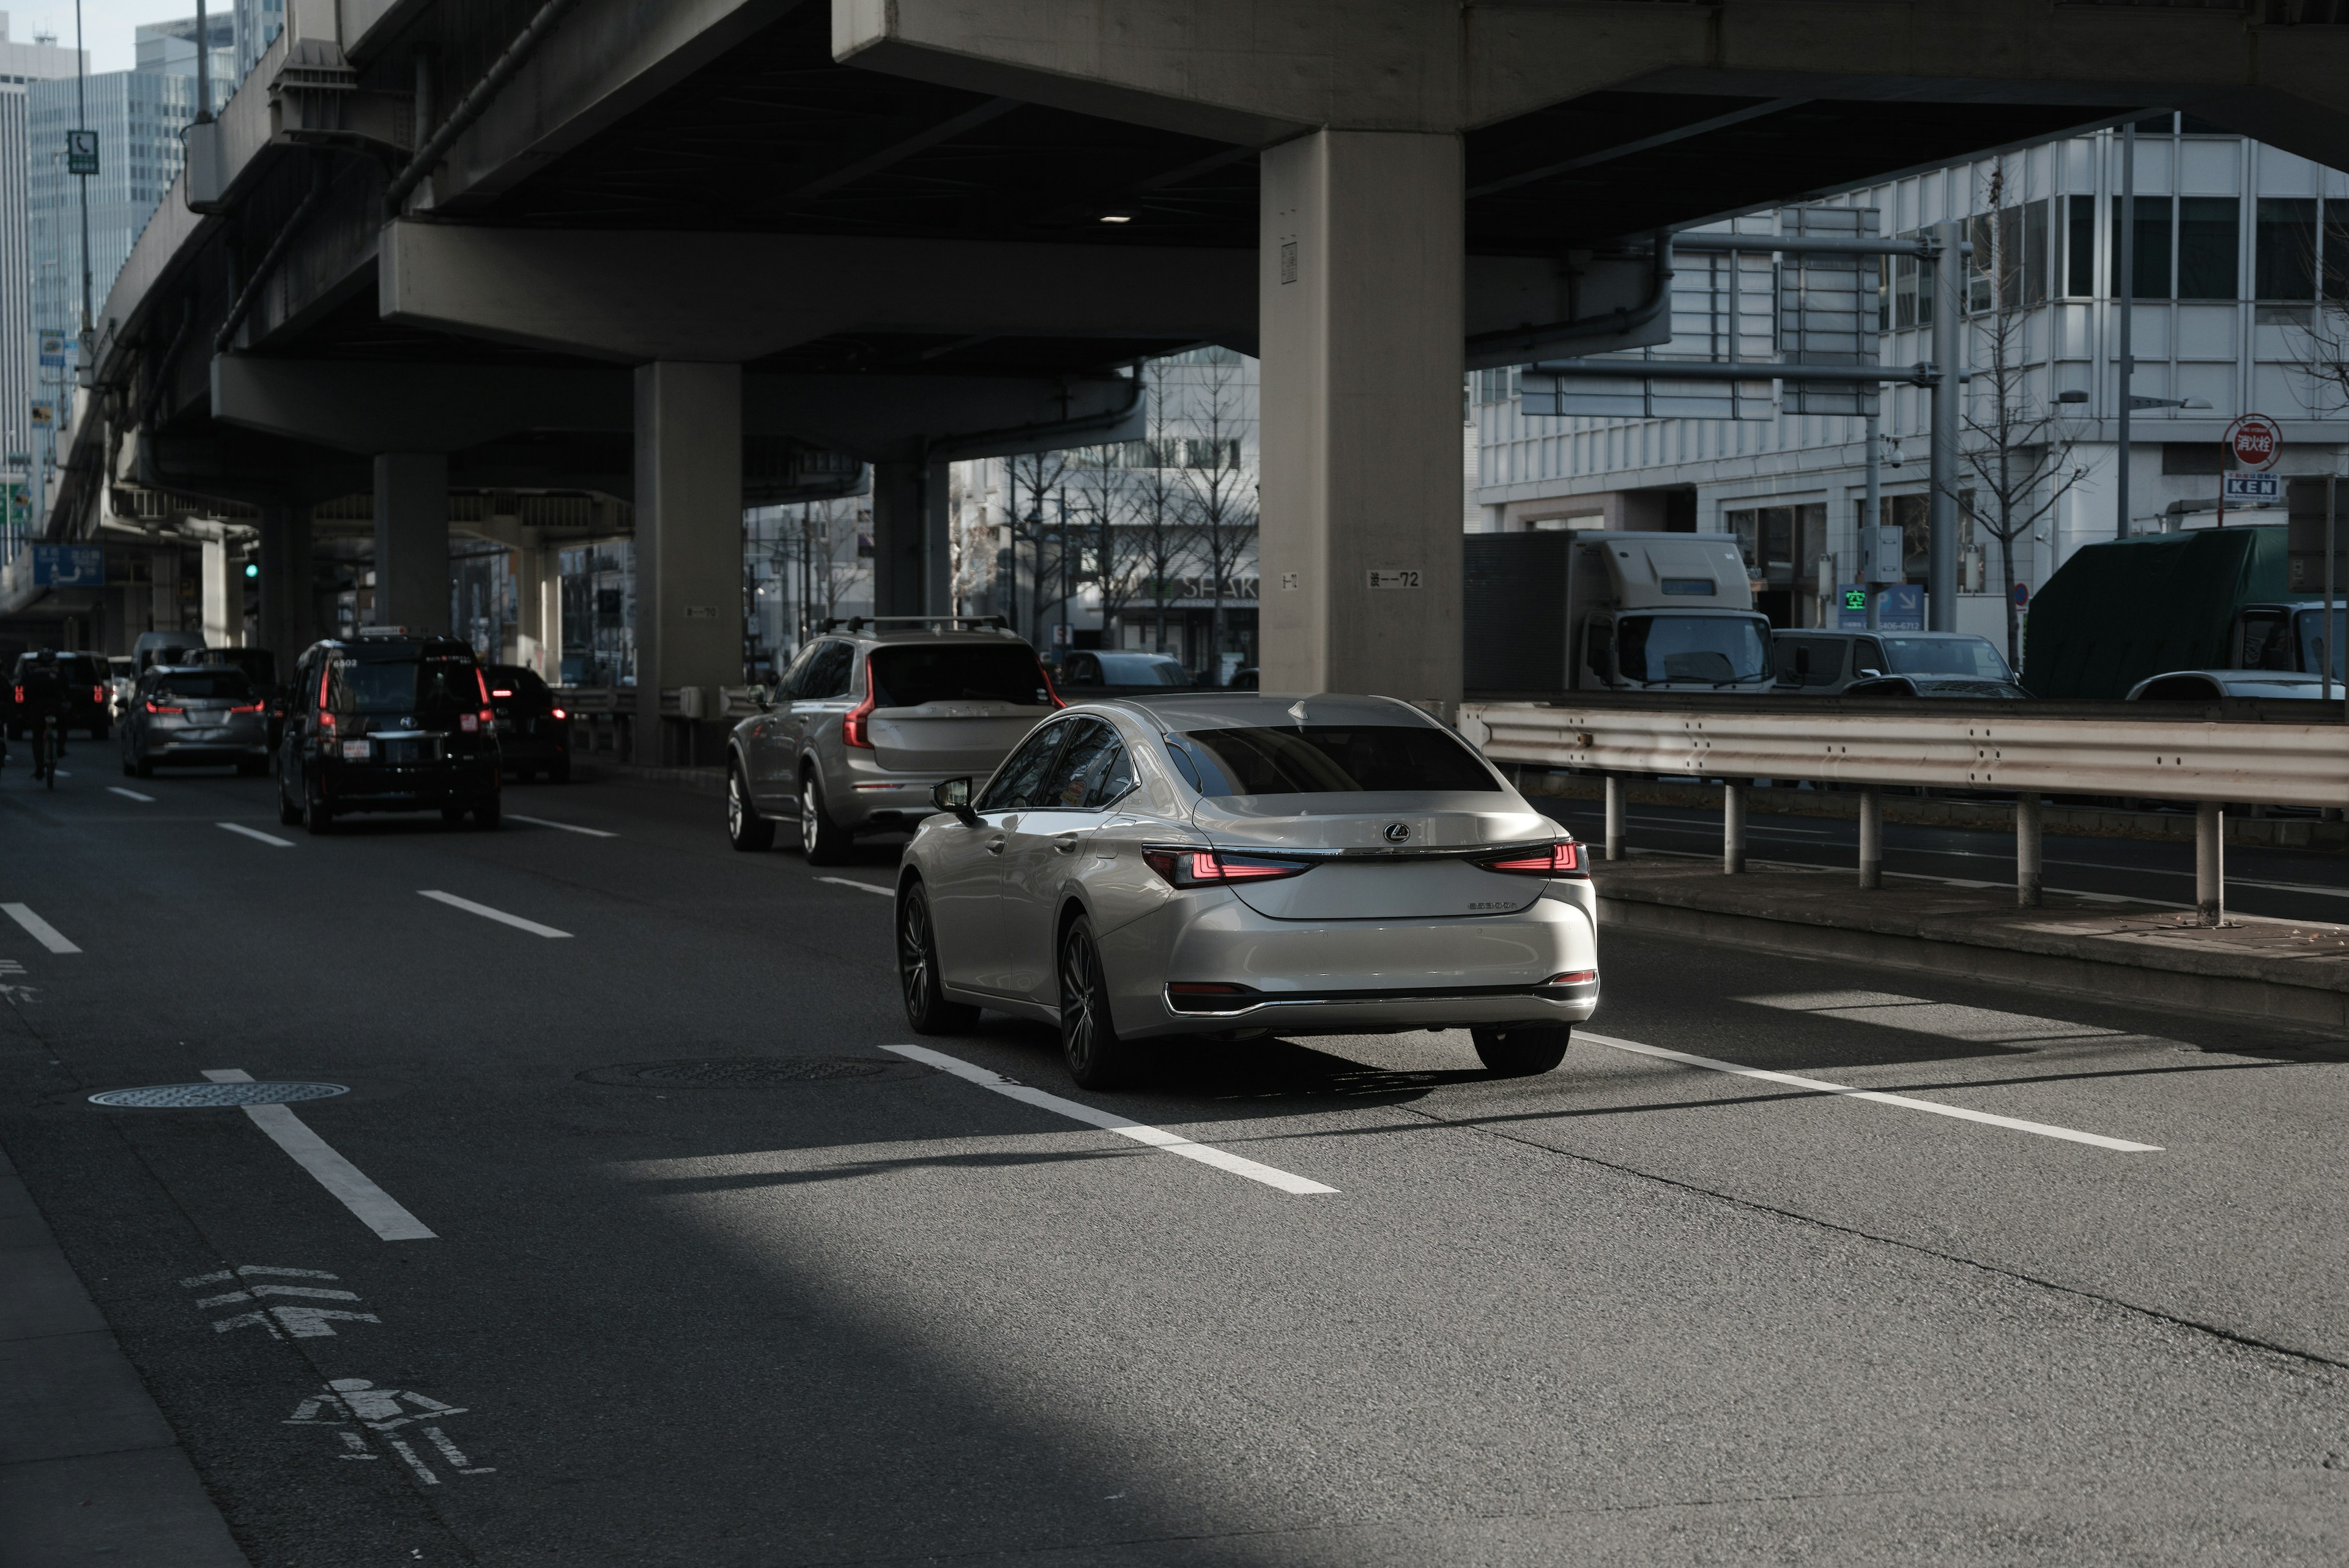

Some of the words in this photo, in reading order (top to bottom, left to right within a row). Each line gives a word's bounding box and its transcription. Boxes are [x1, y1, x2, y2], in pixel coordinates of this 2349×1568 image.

[2237, 435, 2271, 452] 消火栓
[2232, 480, 2273, 494] KEN
[1844, 589, 1866, 611] 空
[333, 659, 357, 668] 6502
